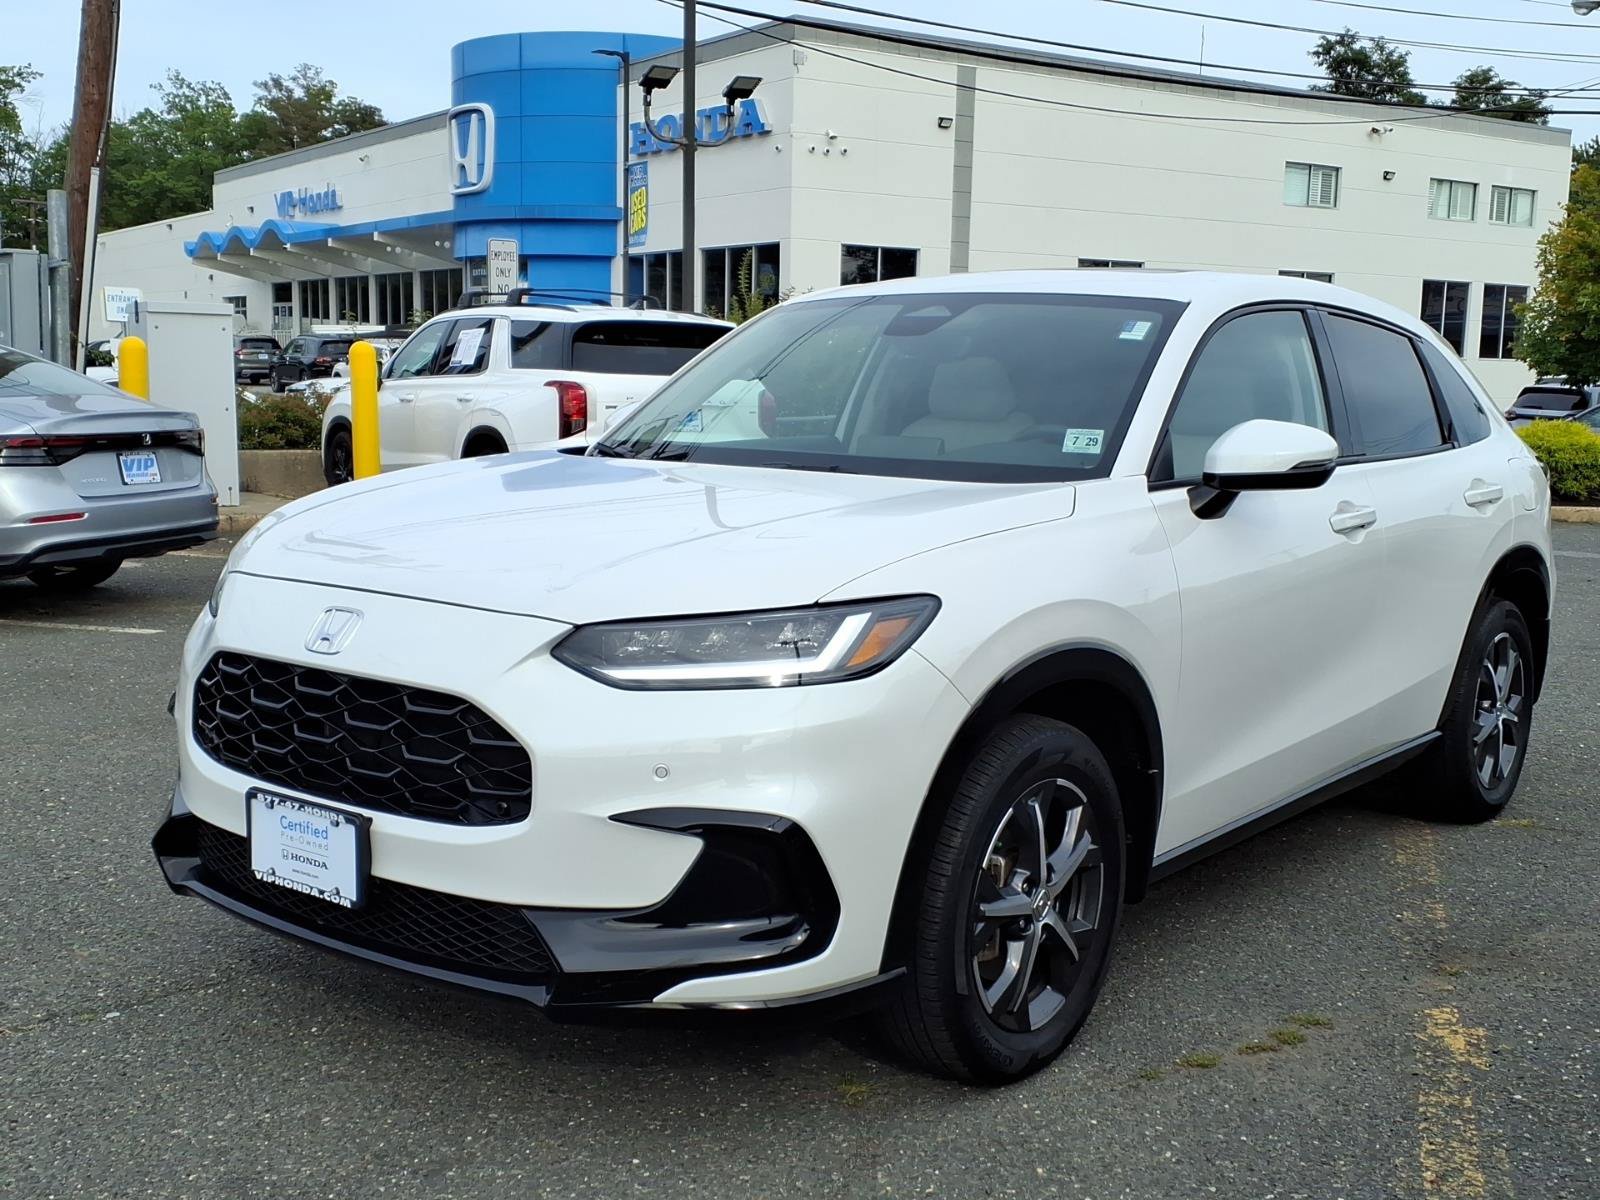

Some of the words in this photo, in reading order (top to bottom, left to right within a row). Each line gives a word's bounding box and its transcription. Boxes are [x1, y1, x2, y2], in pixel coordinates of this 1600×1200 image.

[630, 187, 646, 213] USED
[630, 206, 646, 234] CARS
[490, 250, 516, 262] EMPLOYEE
[495, 267, 511, 278] ONLY
[497, 284, 510, 294] NO
[1072, 436, 1080, 446] 7
[1084, 436, 1099, 447] 29
[121, 457, 155, 472] VIP
[280, 815, 328, 840] Certified
[280, 831, 329, 851] Pre-Owned
[290, 852, 329, 870] HONDA
[254, 870, 352, 909] VIPHONDA.COM
